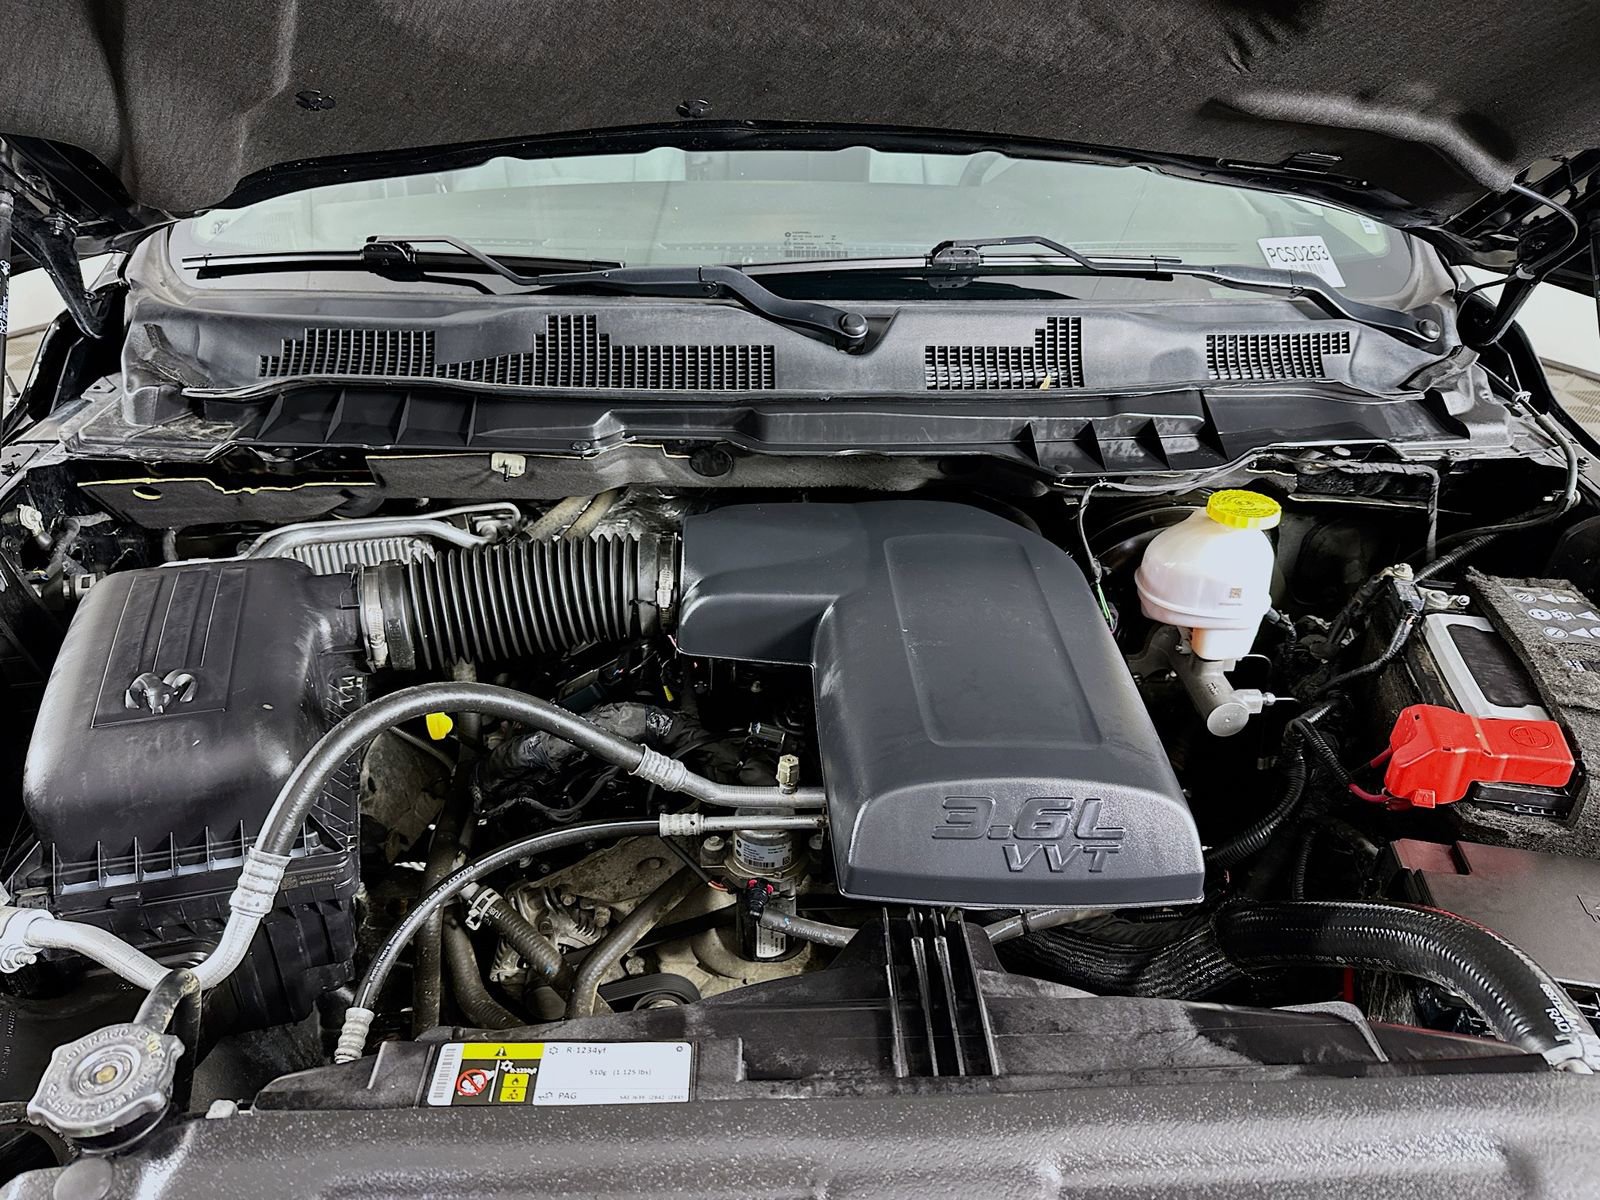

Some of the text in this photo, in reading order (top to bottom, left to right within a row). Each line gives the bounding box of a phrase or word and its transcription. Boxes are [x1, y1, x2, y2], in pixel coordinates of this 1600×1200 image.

[1266, 246, 1329, 263] PCS0263
[932, 796, 1126, 840] 3.6L
[1002, 844, 1121, 872] VVT
[1545, 1007, 1572, 1033] RAD
